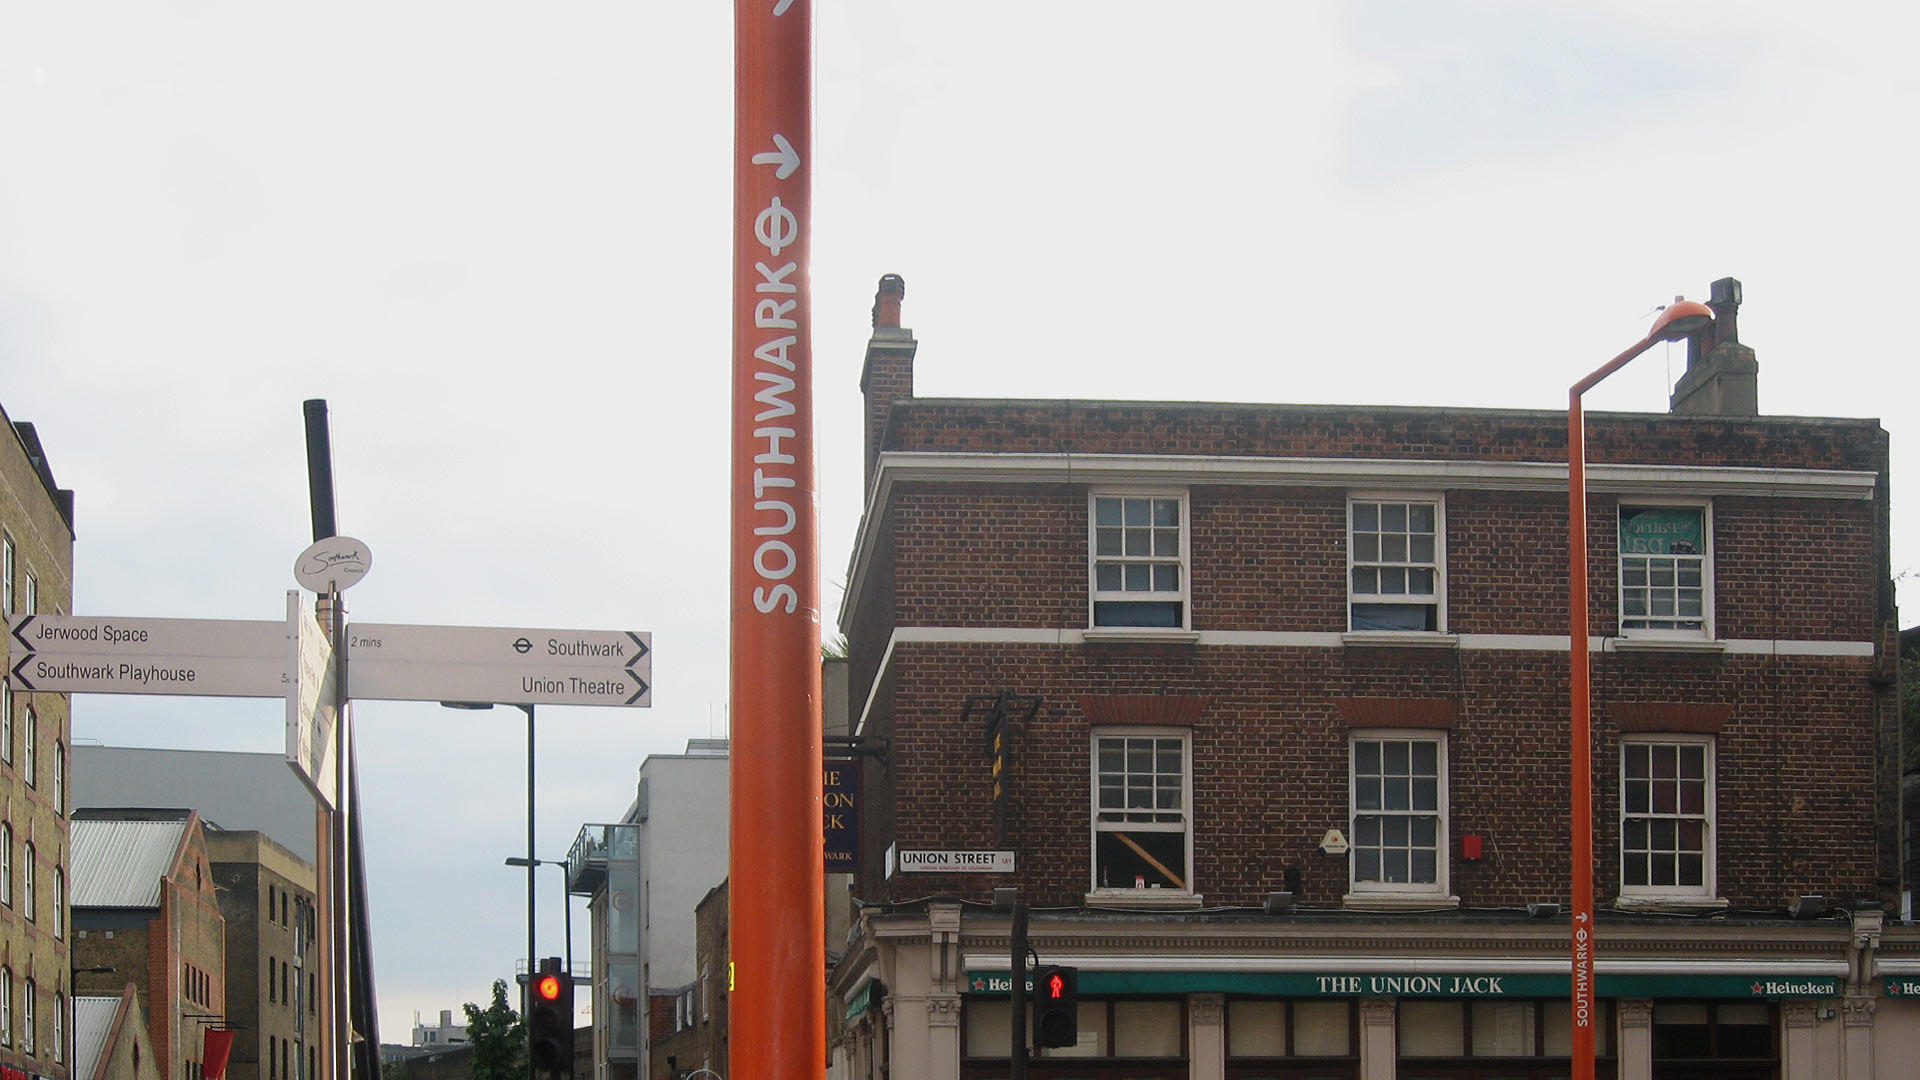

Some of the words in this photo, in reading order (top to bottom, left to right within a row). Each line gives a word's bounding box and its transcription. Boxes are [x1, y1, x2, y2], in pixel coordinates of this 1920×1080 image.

[753, 261, 797, 614] SOUTHWARK
[36, 624, 98, 641] Jerwood
[103, 626, 148, 645] Space
[351, 636, 358, 648] 2
[359, 637, 382, 649] mins
[547, 639, 624, 657] Southwark
[37, 661, 114, 680] Southwark
[119, 664, 196, 685] Playhouse
[522, 676, 564, 694] Union
[569, 677, 625, 695] Theatre
[903, 853, 948, 864] UNION
[954, 853, 996, 864] STREET
[1316, 976, 1362, 993] THE
[1369, 976, 1442, 993] UNION
[1449, 977, 1504, 993] JACK
[1577, 943, 1588, 1027] SOUTHWARK
[1766, 982, 1834, 994] Heineken
